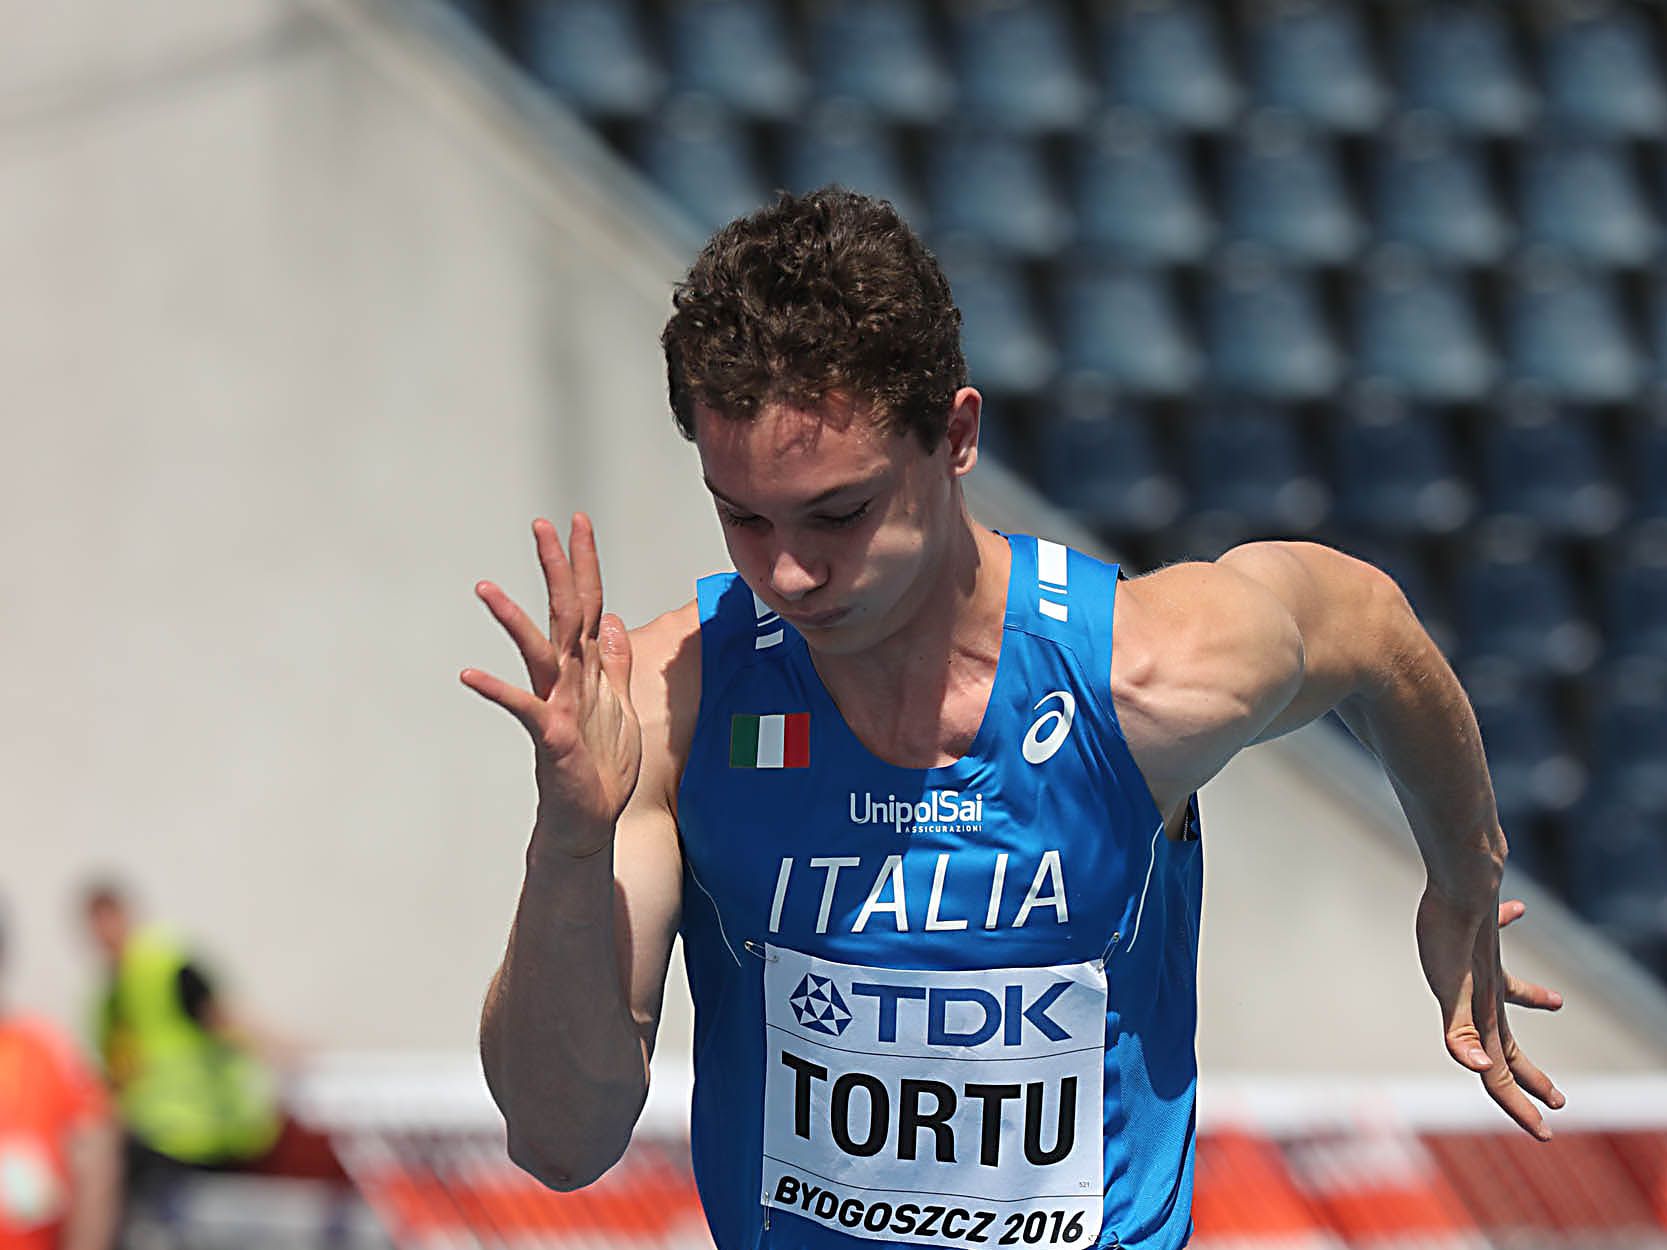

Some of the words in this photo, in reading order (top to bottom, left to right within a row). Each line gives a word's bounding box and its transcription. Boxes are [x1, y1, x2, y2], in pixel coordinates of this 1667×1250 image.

[850, 790, 983, 833] UnipolSai
[905, 823, 983, 833] ASSICURAZIONI
[769, 850, 1069, 934] ITALIA
[851, 981, 1074, 1047] TDK
[781, 1050, 1078, 1168] TORTU
[774, 1175, 998, 1243] BYDGOSZCZ
[998, 1210, 1085, 1246] 2016
